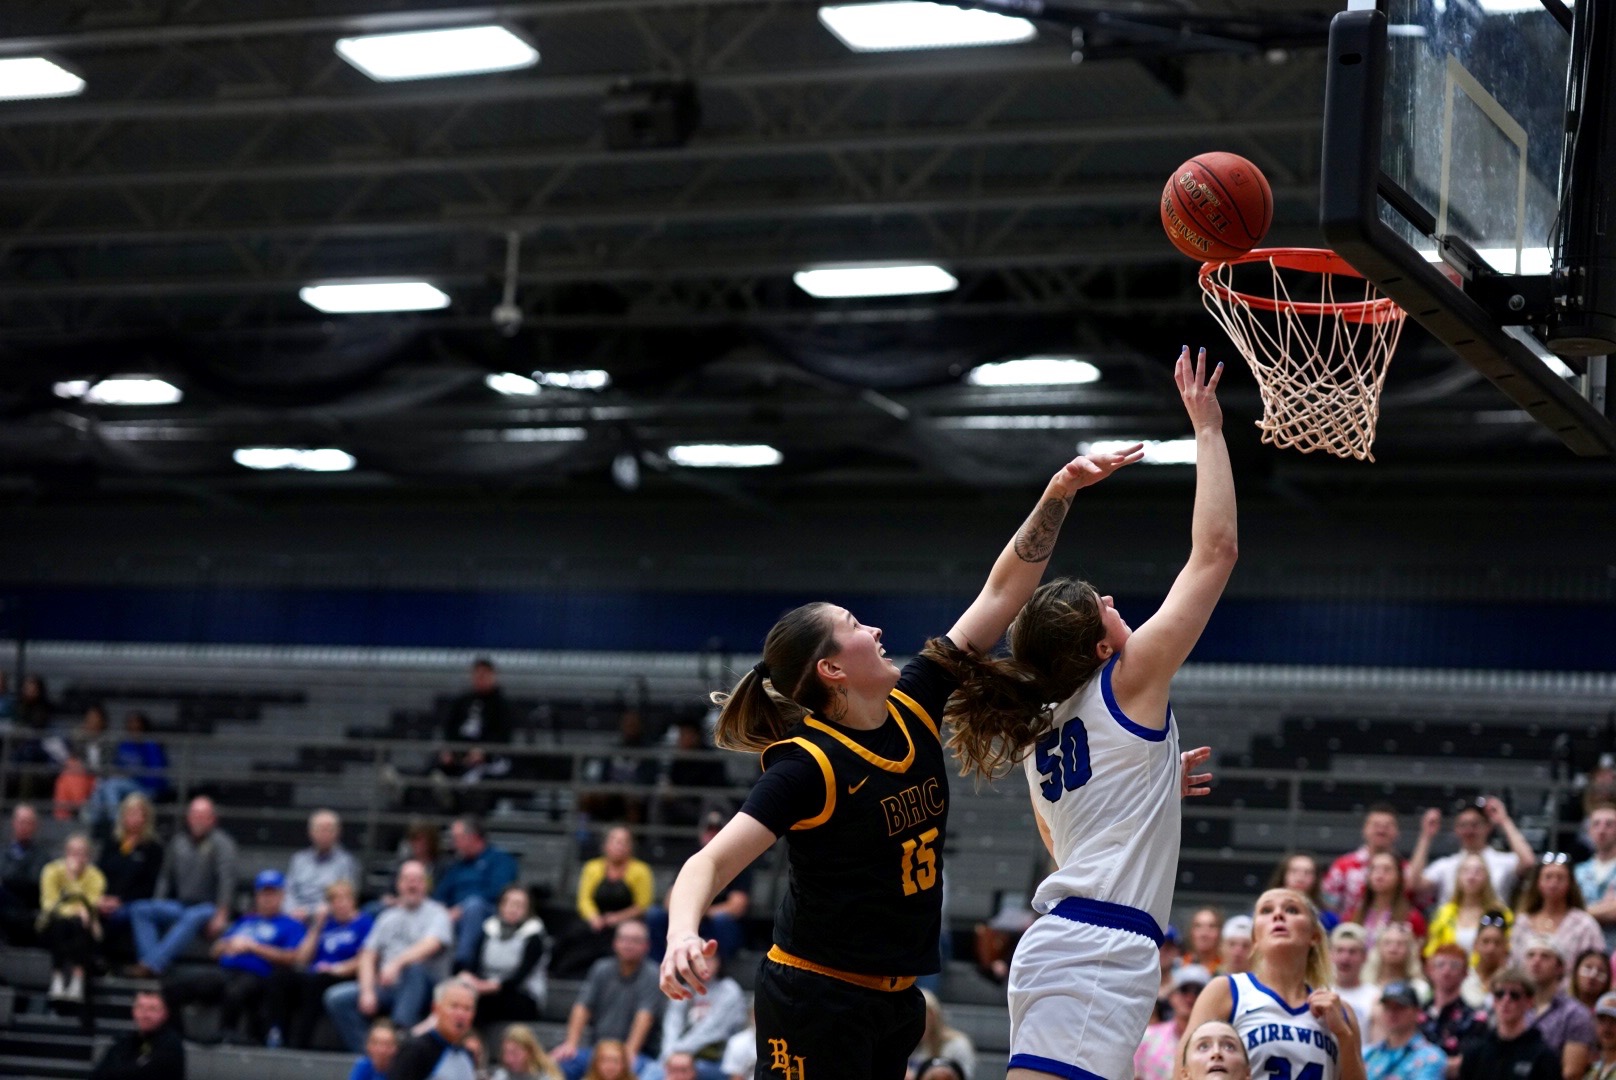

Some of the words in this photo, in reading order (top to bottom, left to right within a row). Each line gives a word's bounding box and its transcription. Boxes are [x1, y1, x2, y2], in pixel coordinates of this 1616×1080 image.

[1162, 186, 1213, 253] SPALDING
[1035, 716, 1092, 804] 50
[879, 777, 944, 837] BHC
[901, 826, 938, 896] 15
